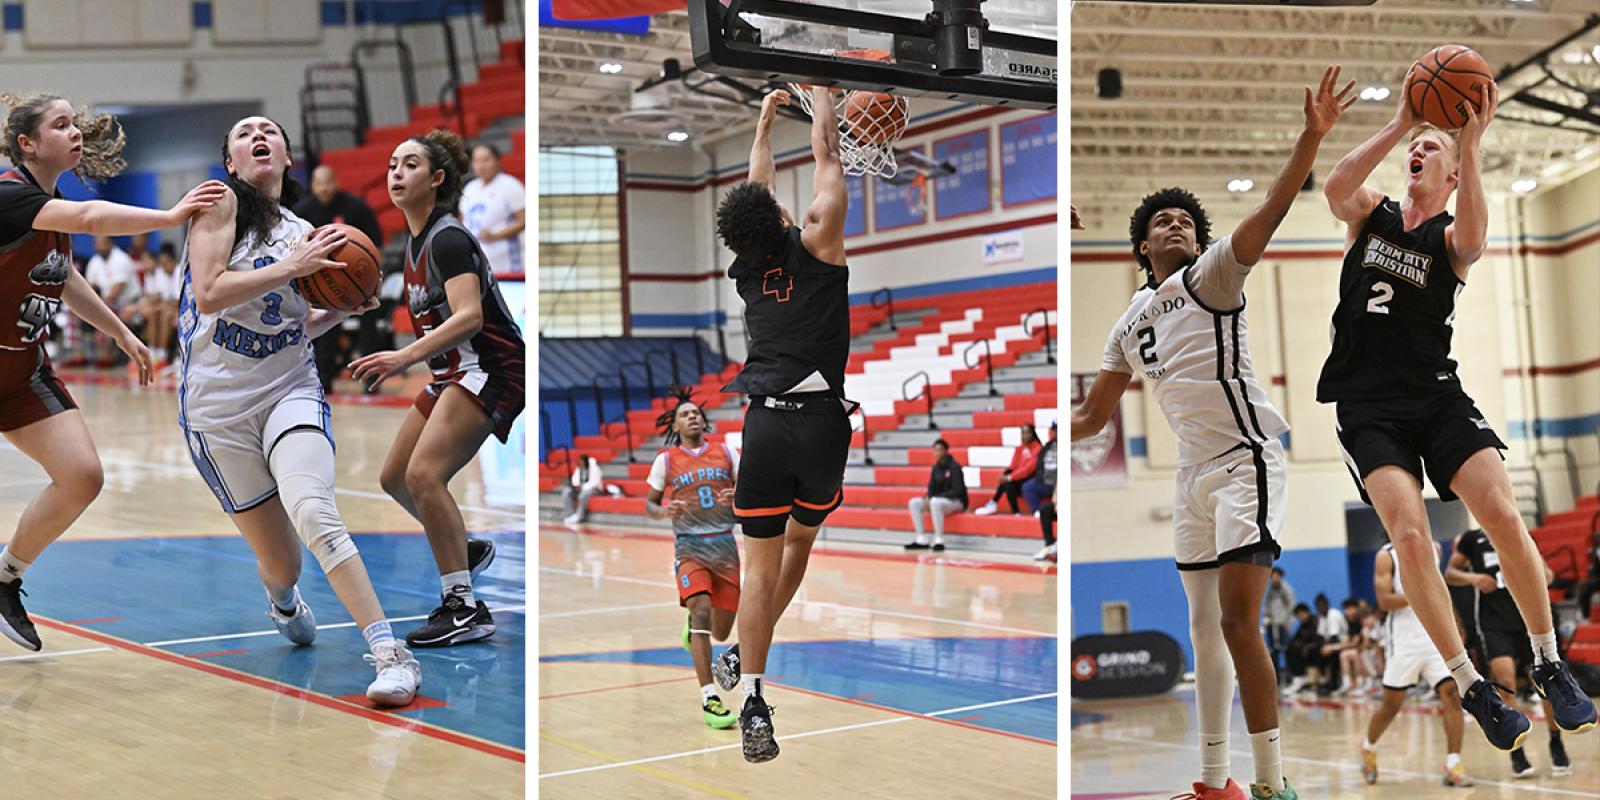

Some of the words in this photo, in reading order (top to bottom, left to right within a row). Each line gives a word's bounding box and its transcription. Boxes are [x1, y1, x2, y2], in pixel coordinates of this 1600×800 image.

[763, 267, 794, 303] 4
[1367, 281, 1395, 315] 2
[260, 292, 284, 326] 3
[1136, 325, 1159, 366] 2
[698, 485, 715, 509] 8
[681, 573, 691, 588] 8
